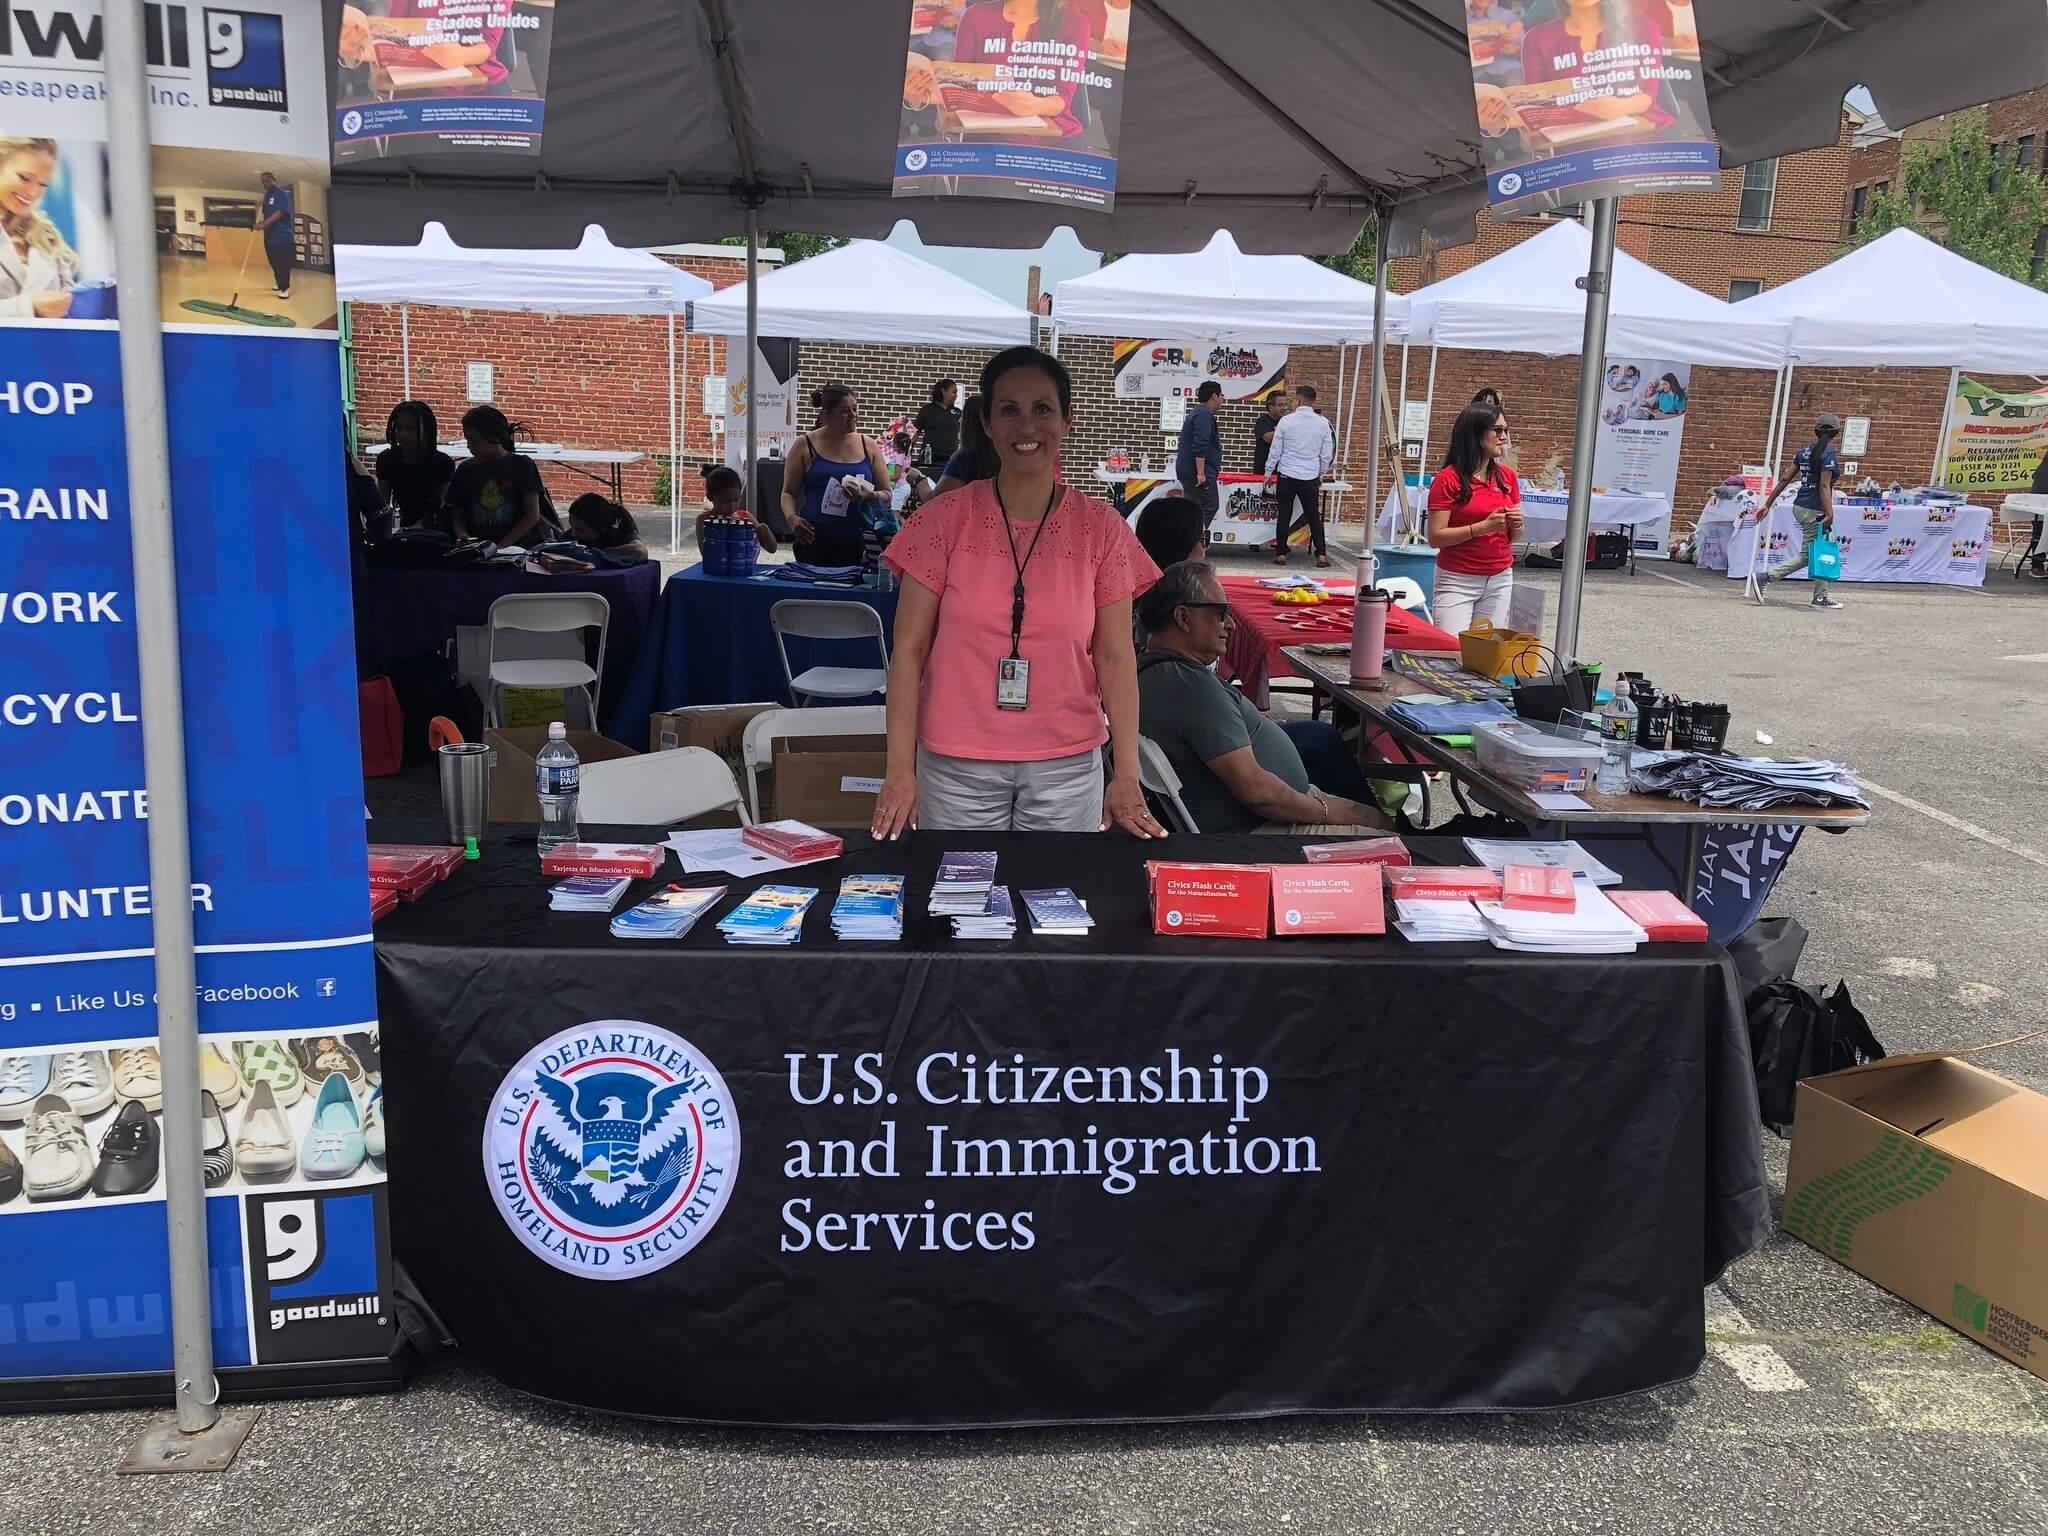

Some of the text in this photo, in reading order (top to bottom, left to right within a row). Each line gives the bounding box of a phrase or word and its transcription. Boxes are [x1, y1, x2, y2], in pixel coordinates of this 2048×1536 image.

[427, 14, 540, 31] Estados Unidos
[408, 31, 460, 46] empezó
[984, 38, 1097, 61] Mi camino a la
[1553, 53, 1577, 71] Mi
[1582, 42, 1651, 64] camino
[1653, 48, 1660, 56] a
[1066, 57, 1080, 68] de
[1643, 56, 1656, 67] de
[995, 64, 1113, 89] Estados Unidos
[1572, 66, 1693, 90] Estados Unidos
[977, 80, 1032, 93] empezó
[1556, 84, 1614, 106] empezó
[151, 86, 199, 109] Inc.
[212, 87, 284, 104] goodwill
[1618, 427, 1642, 435] PERSONAL
[1166, 439, 1177, 448] 10
[1410, 447, 1418, 455] 11
[1846, 464, 1856, 473] 13
[1969, 471, 1995, 483] 686
[0, 489, 110, 520] RAIN
[0, 591, 123, 624] ORK
[560, 769, 577, 778] DEE
[560, 777, 577, 786] PAR
[552, 865, 577, 873] Tarjetas
[1168, 880, 1236, 890] Civics Flash Cards
[1282, 880, 1306, 888] Civics
[1328, 879, 1350, 887] Cards
[1416, 889, 1437, 897] Civics
[1438, 889, 1457, 897] Flash
[0, 883, 215, 924] LUNTER
[56, 993, 105, 1013] Like
[113, 990, 146, 1008] Us
[500, 1033, 726, 1130] U.S. DEPARTMENT OF
[784, 1048, 1269, 1122] U.S. Citizenship
[783, 1121, 1322, 1195] and Immigration
[498, 1160, 724, 1266] HOMELAND SECURITY
[780, 1198, 1036, 1252] Services
[270, 1296, 380, 1330] goodwill
